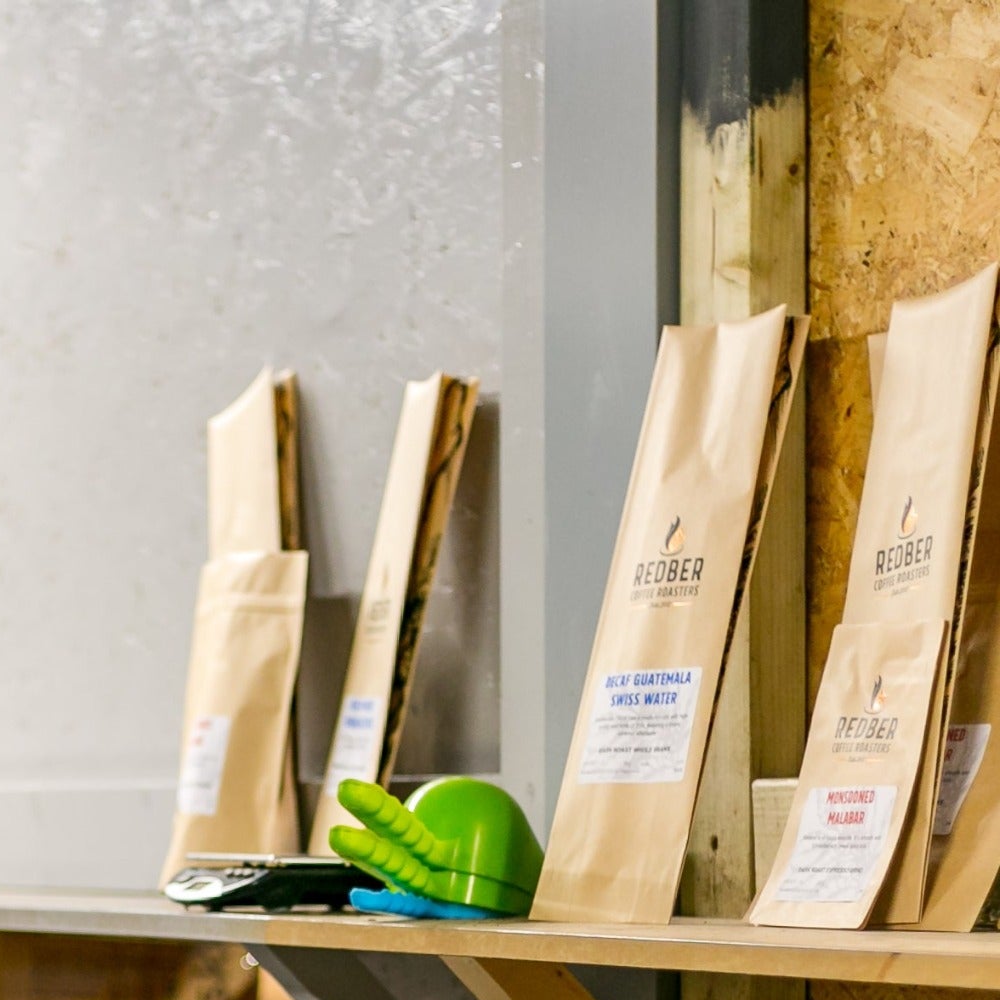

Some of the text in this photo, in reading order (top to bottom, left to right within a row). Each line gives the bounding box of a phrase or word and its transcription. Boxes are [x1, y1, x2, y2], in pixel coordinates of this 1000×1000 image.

[876, 535, 933, 575] REDBER
[633, 557, 704, 586] REDBER
[896, 564, 930, 583] ROASTERS
[656, 585, 699, 598] ROASTERS
[605, 671, 692, 688] DECAF GUATEMALA
[611, 691, 678, 707] SWISS WATER
[834, 716, 898, 739] REDBER
[826, 790, 875, 804] MONSOONED
[827, 811, 865, 825] MALABAR
